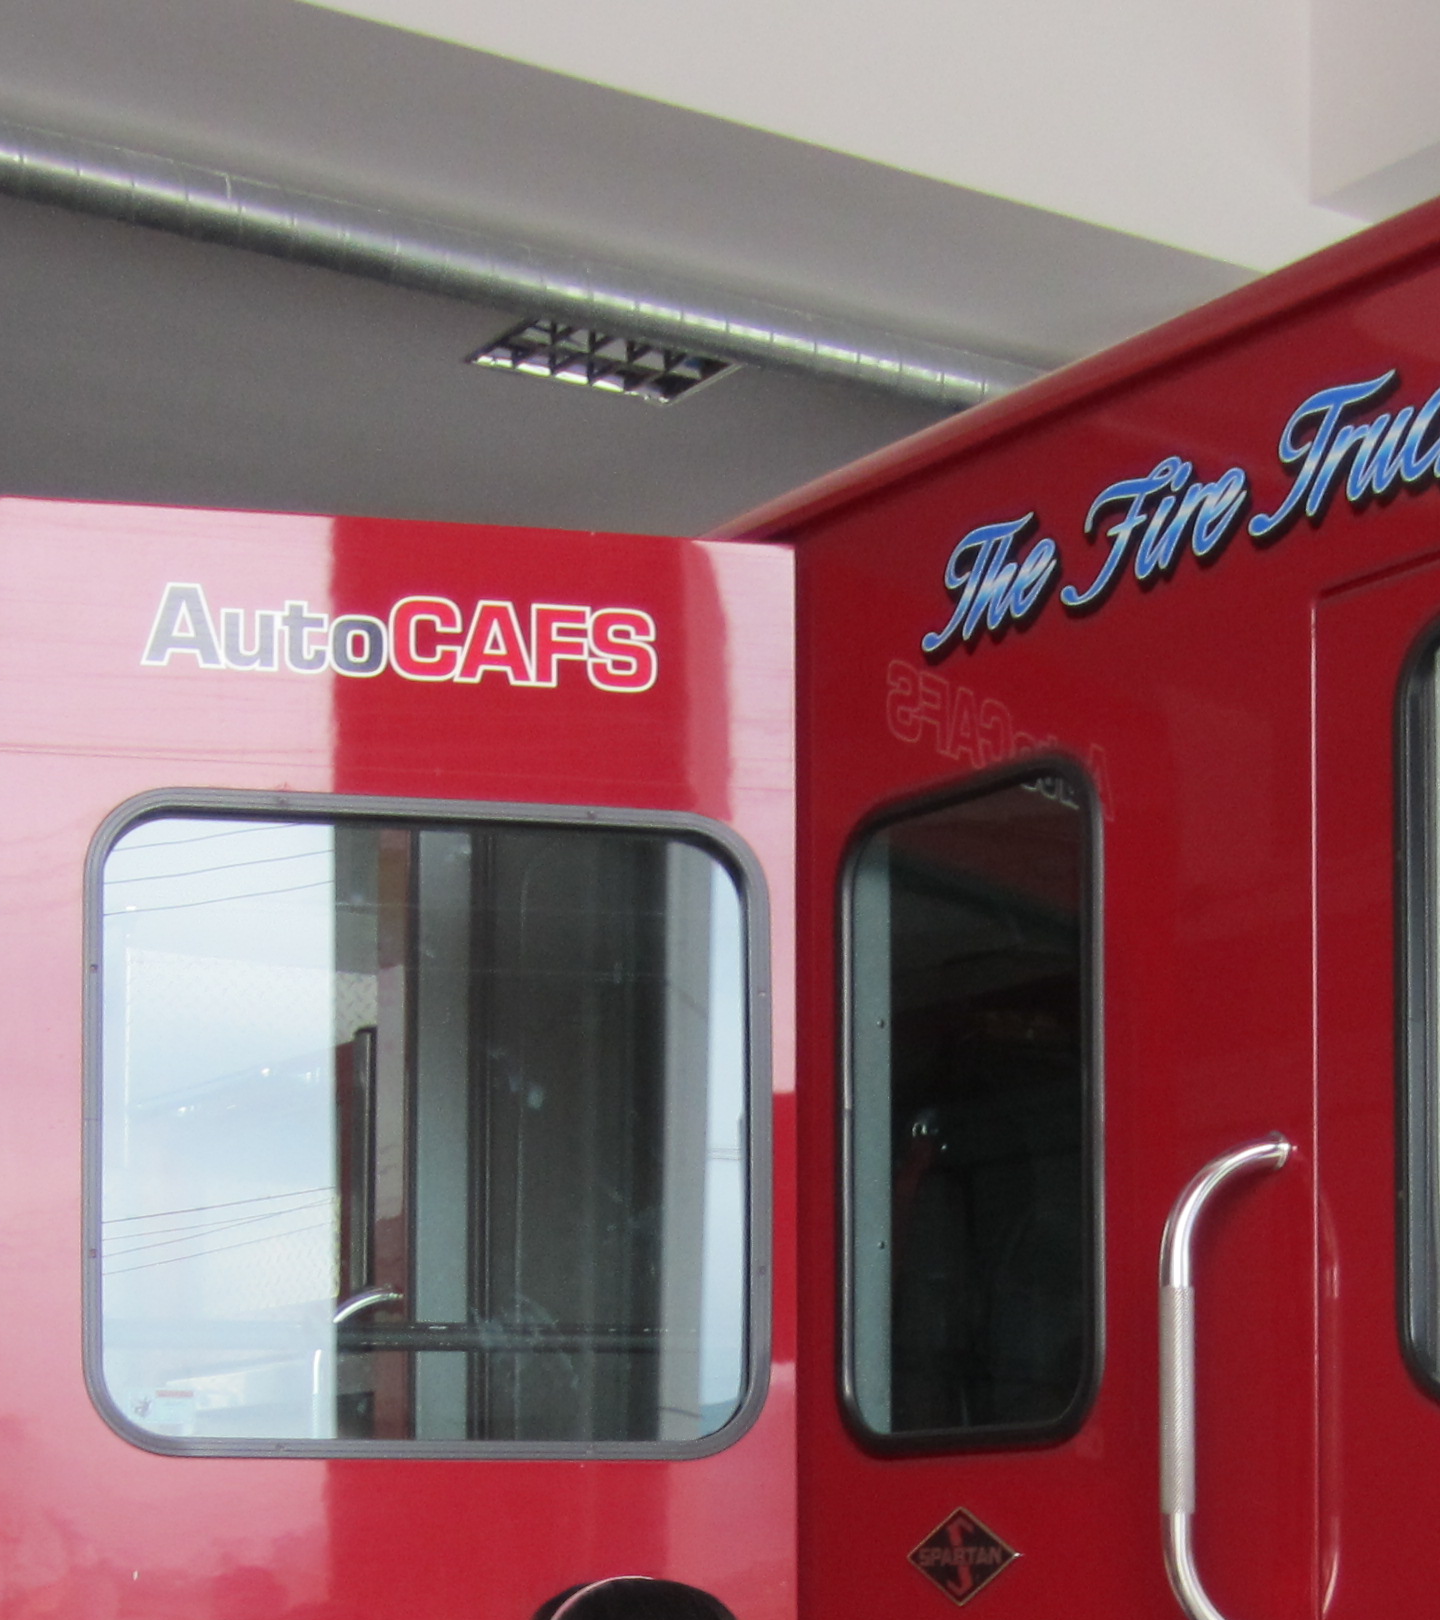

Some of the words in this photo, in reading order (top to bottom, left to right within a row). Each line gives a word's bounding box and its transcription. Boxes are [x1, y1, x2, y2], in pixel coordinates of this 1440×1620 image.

[922, 511, 1057, 654] The
[1061, 456, 1247, 606] Fire
[141, 581, 658, 693] AutoCAFS
[919, 1546, 1003, 1567] SPARTAN
